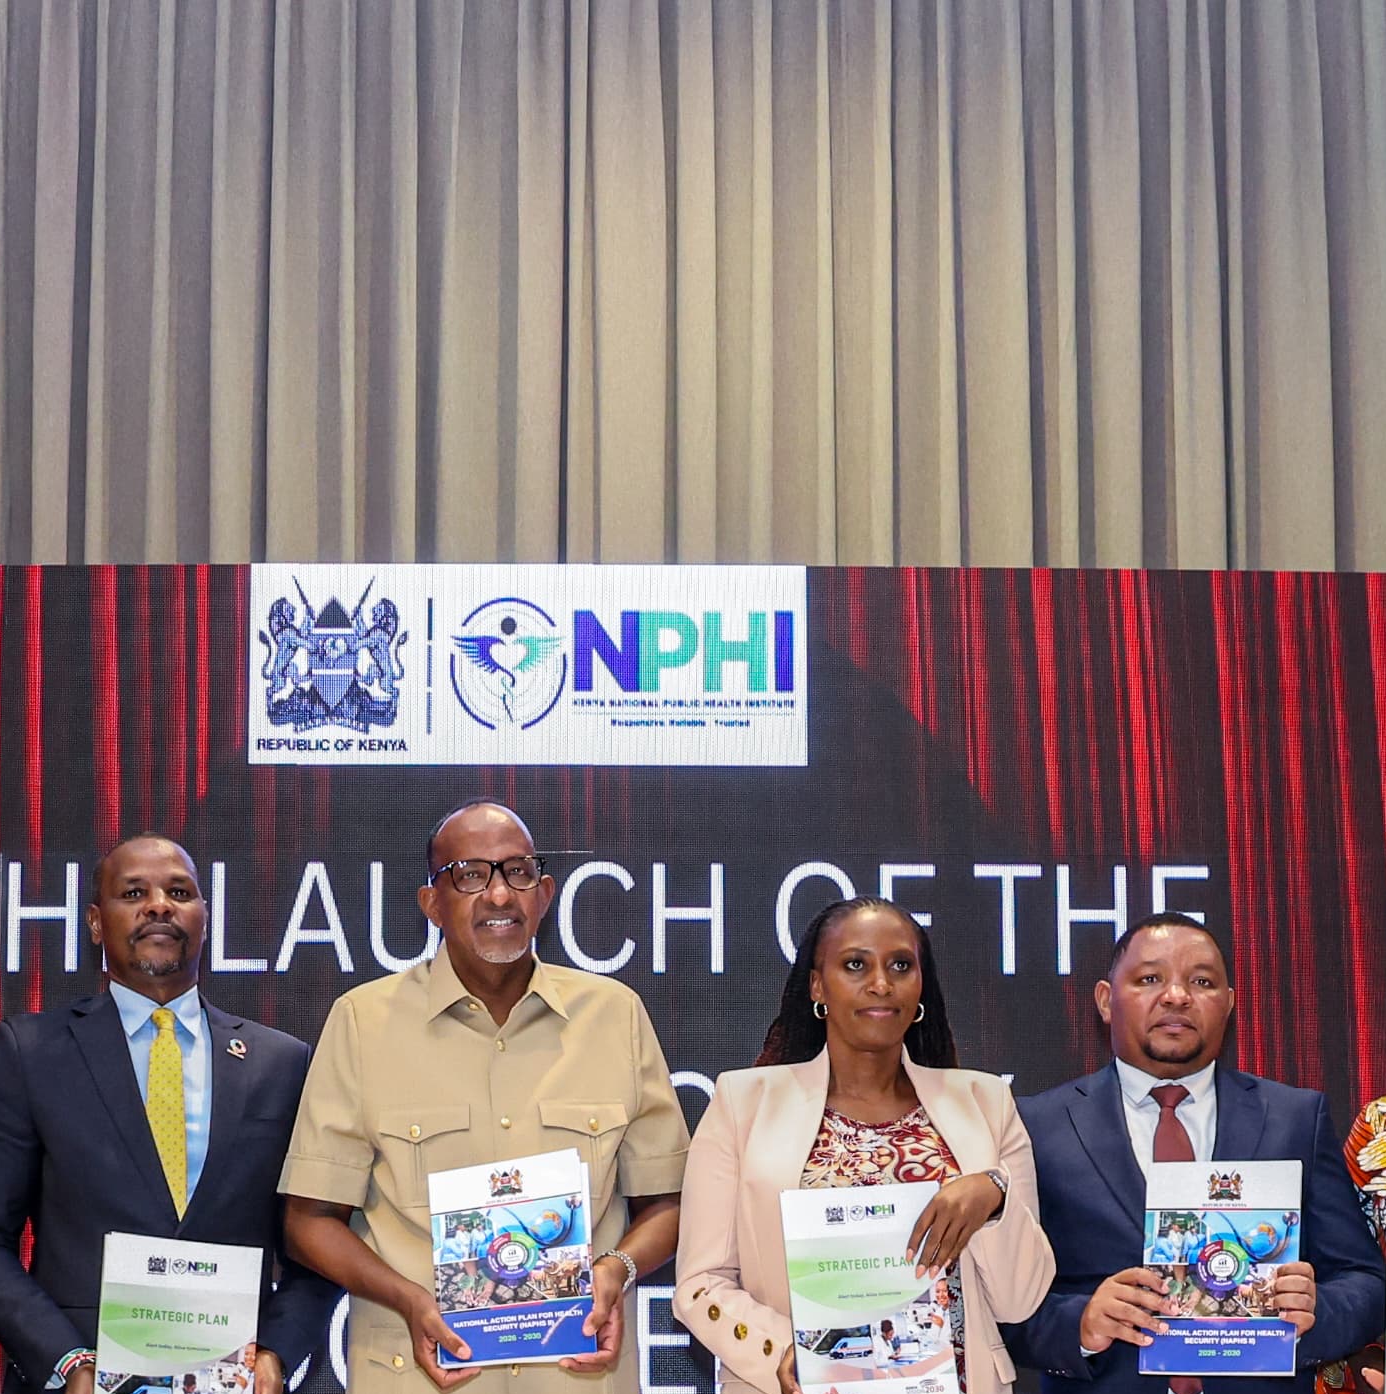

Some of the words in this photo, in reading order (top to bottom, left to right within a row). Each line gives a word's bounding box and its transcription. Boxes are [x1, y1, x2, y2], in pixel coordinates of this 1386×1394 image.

[574, 610, 794, 693] NPHI
[256, 738, 330, 753] REPUBLIC
[334, 738, 354, 752] OF
[357, 738, 408, 752] KENYA
[210, 860, 725, 975] LAUCH
[865, 1204, 895, 1216] NPHI
[188, 1261, 217, 1273] NPHI
[818, 1257, 880, 1272] STRATEGIC
[131, 1308, 194, 1323] STRATEGIC
[198, 1313, 229, 1326] PLAN
[1156, 1329, 1193, 1337] TIONAL
[1193, 1329, 1220, 1337] ACTION
[1220, 1329, 1240, 1337] PLAN
[1241, 1329, 1257, 1337] FOR
[1257, 1329, 1286, 1337] HEALTH
[1184, 1337, 1220, 1345] SECURITY
